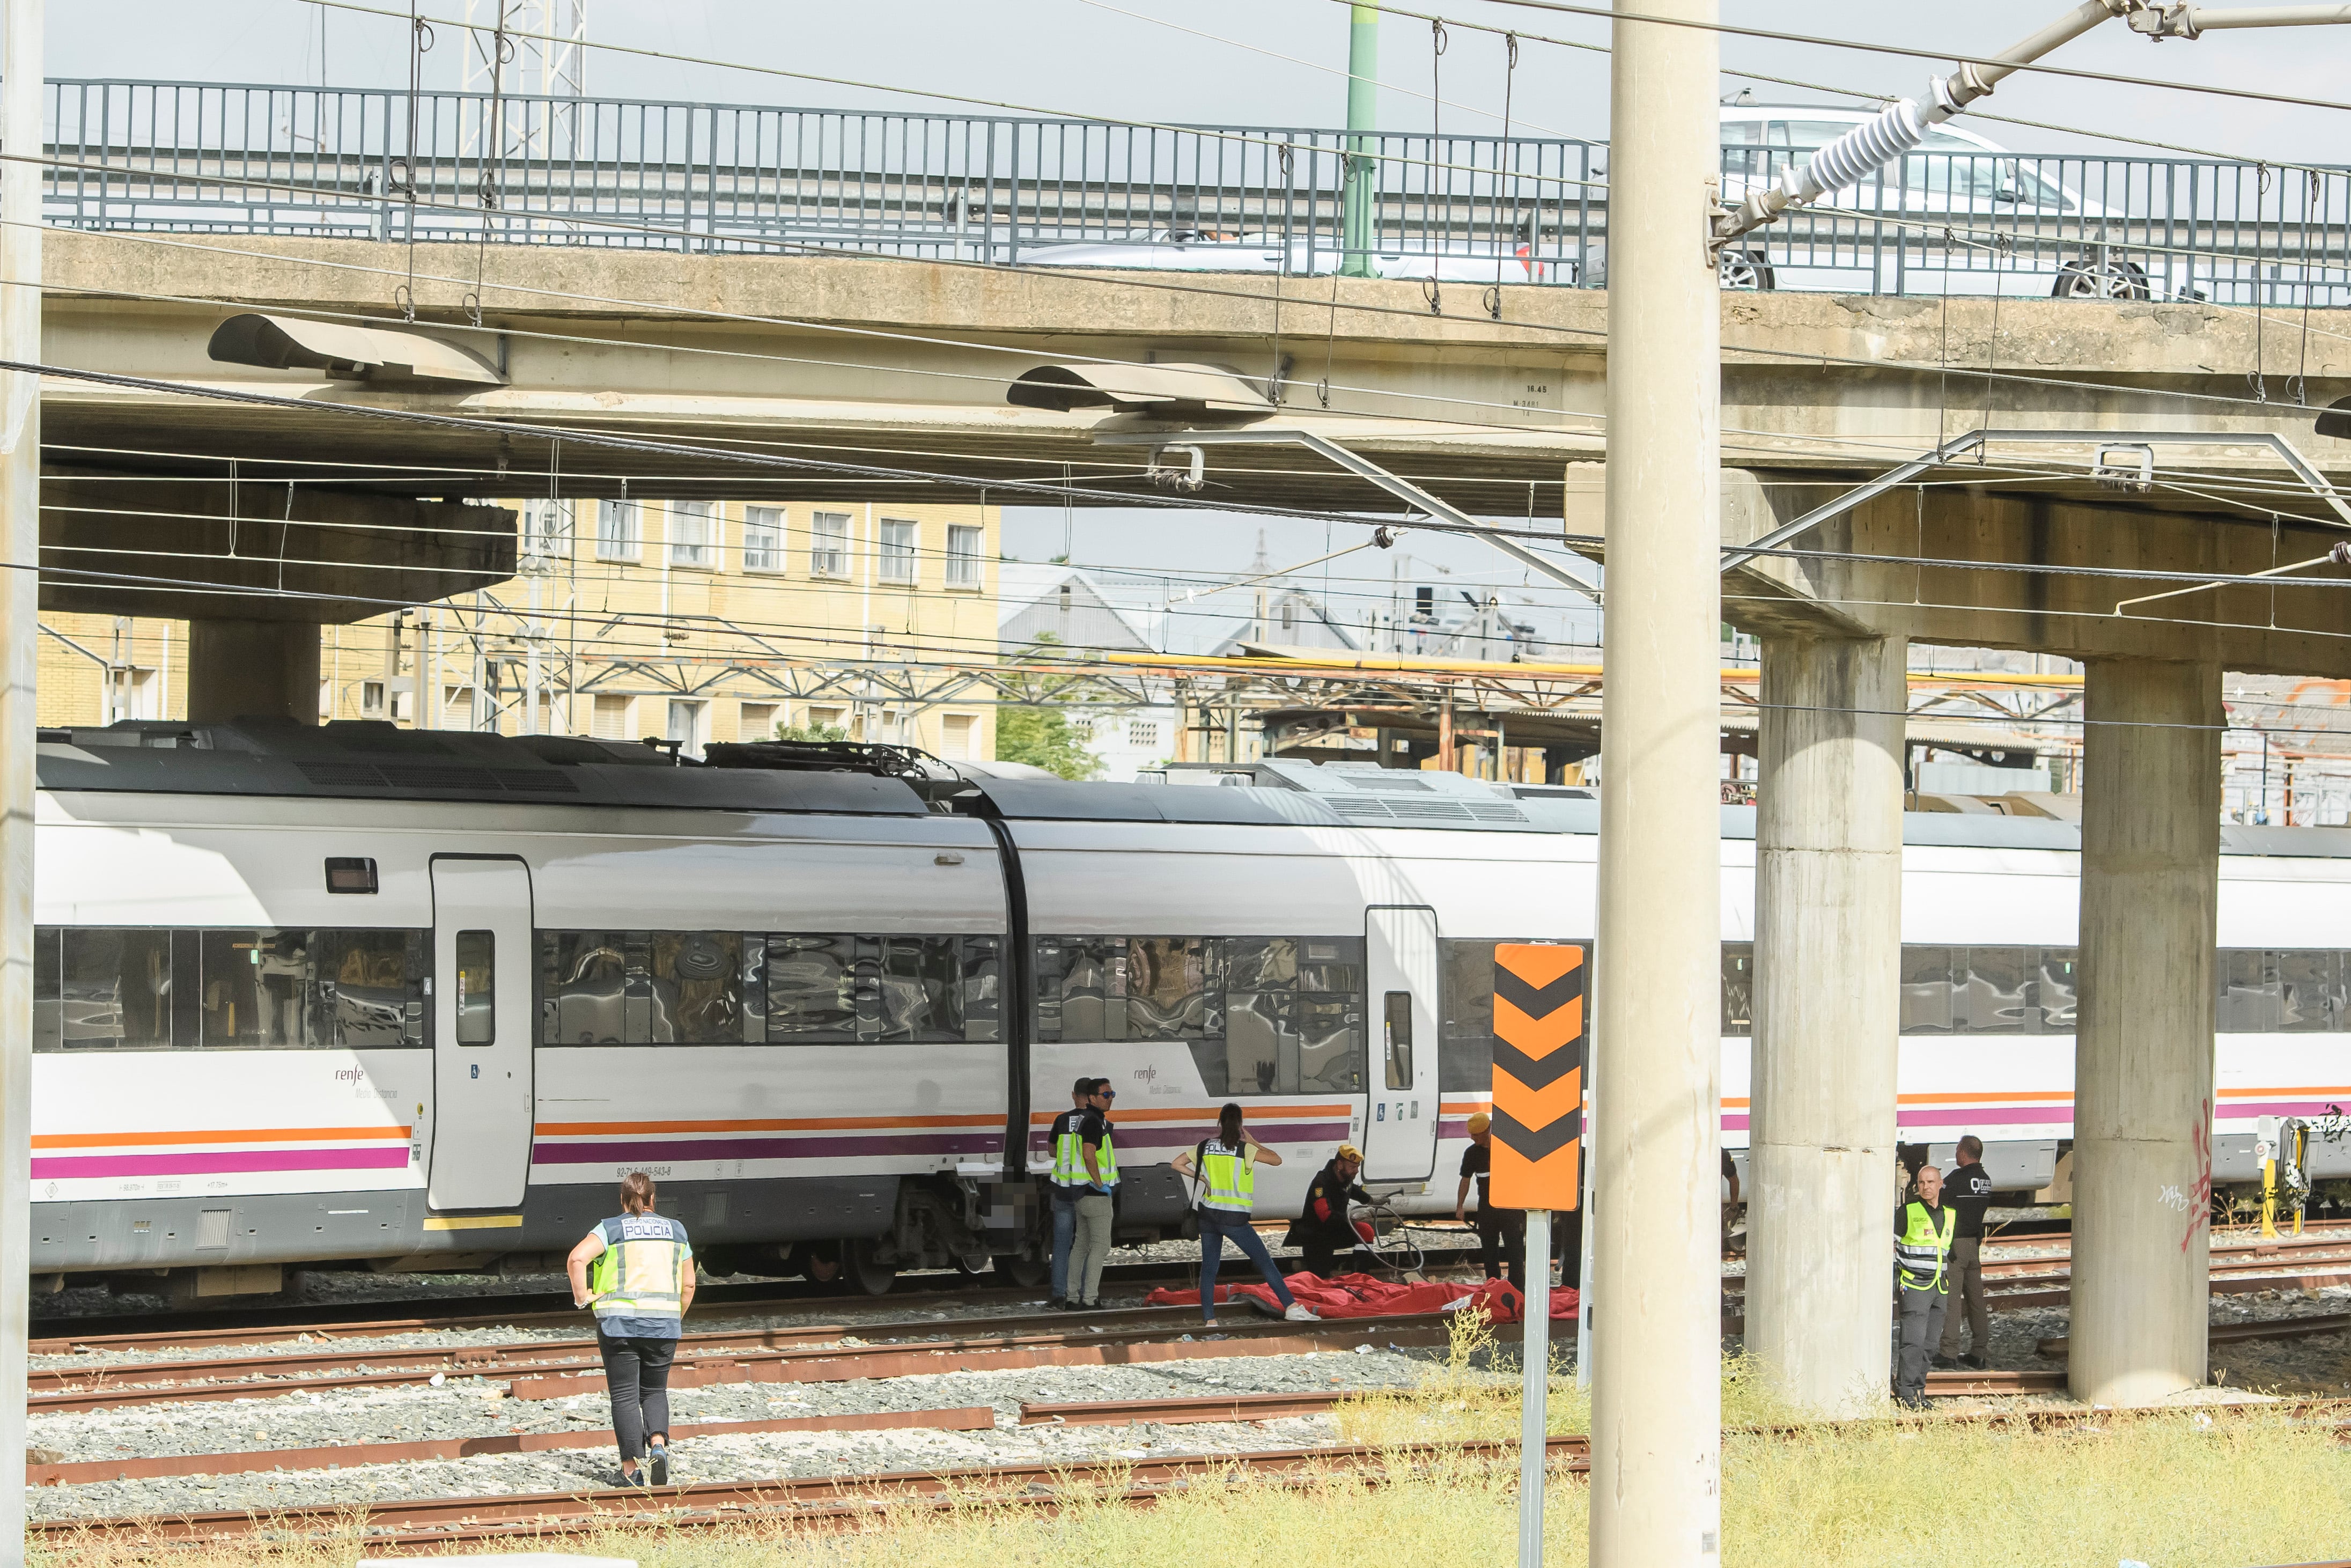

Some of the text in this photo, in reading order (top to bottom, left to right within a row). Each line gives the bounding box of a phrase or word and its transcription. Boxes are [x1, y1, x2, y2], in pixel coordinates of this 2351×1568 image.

[335, 1064, 364, 1086] renfe
[1134, 1064, 1156, 1085] renfe
[356, 1087, 397, 1099] Media Distancia
[625, 1225, 671, 1236] POLICIA
